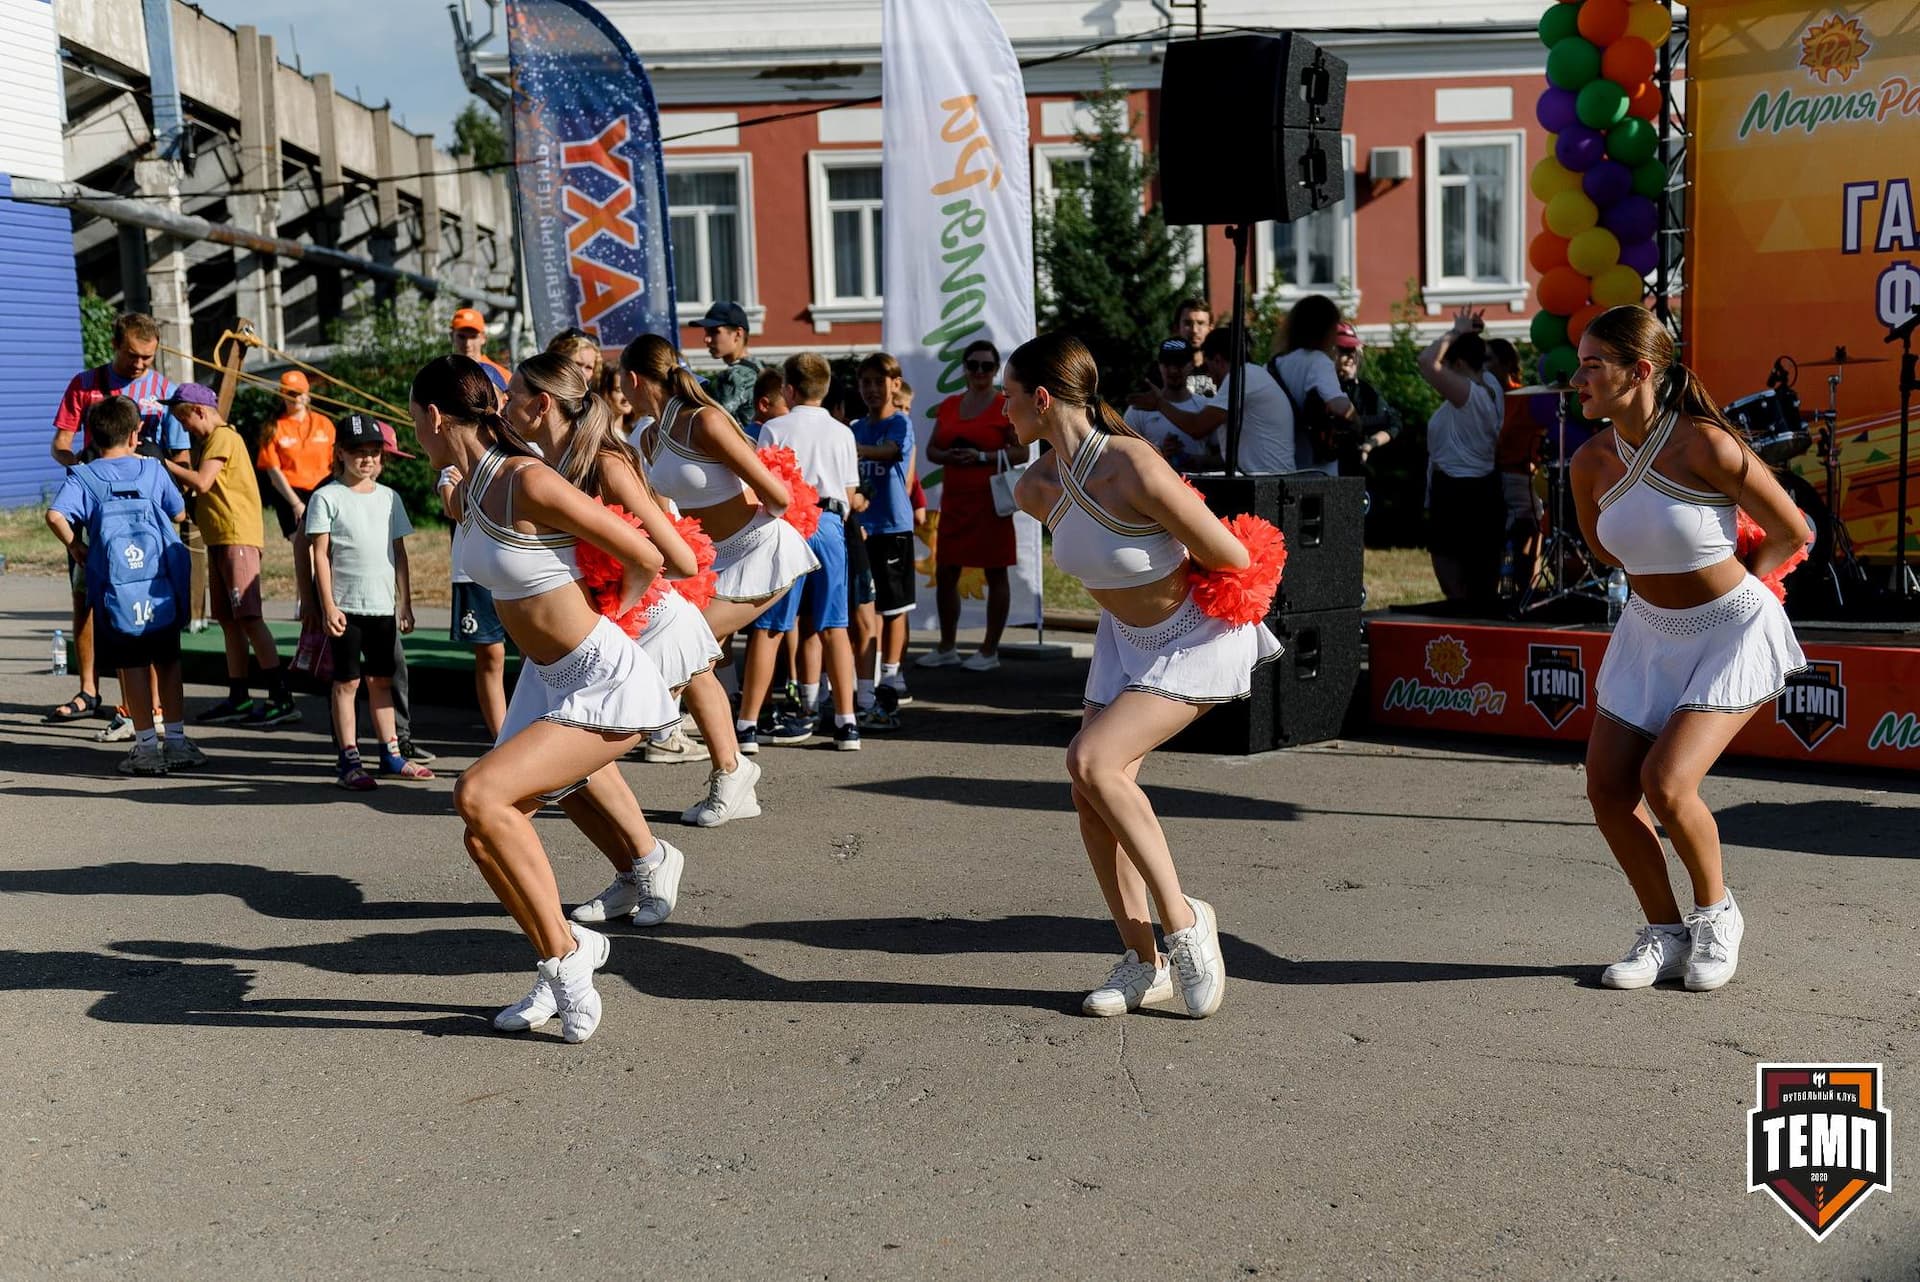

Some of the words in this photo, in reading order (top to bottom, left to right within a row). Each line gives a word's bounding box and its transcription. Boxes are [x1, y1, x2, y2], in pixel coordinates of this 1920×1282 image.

[1842, 178, 1920, 254] ГА
[133, 600, 154, 625] 14
[1384, 677, 1506, 715] МарияРа
[1531, 668, 1580, 699] ТЕМП
[1785, 685, 1839, 718] ТЕМП
